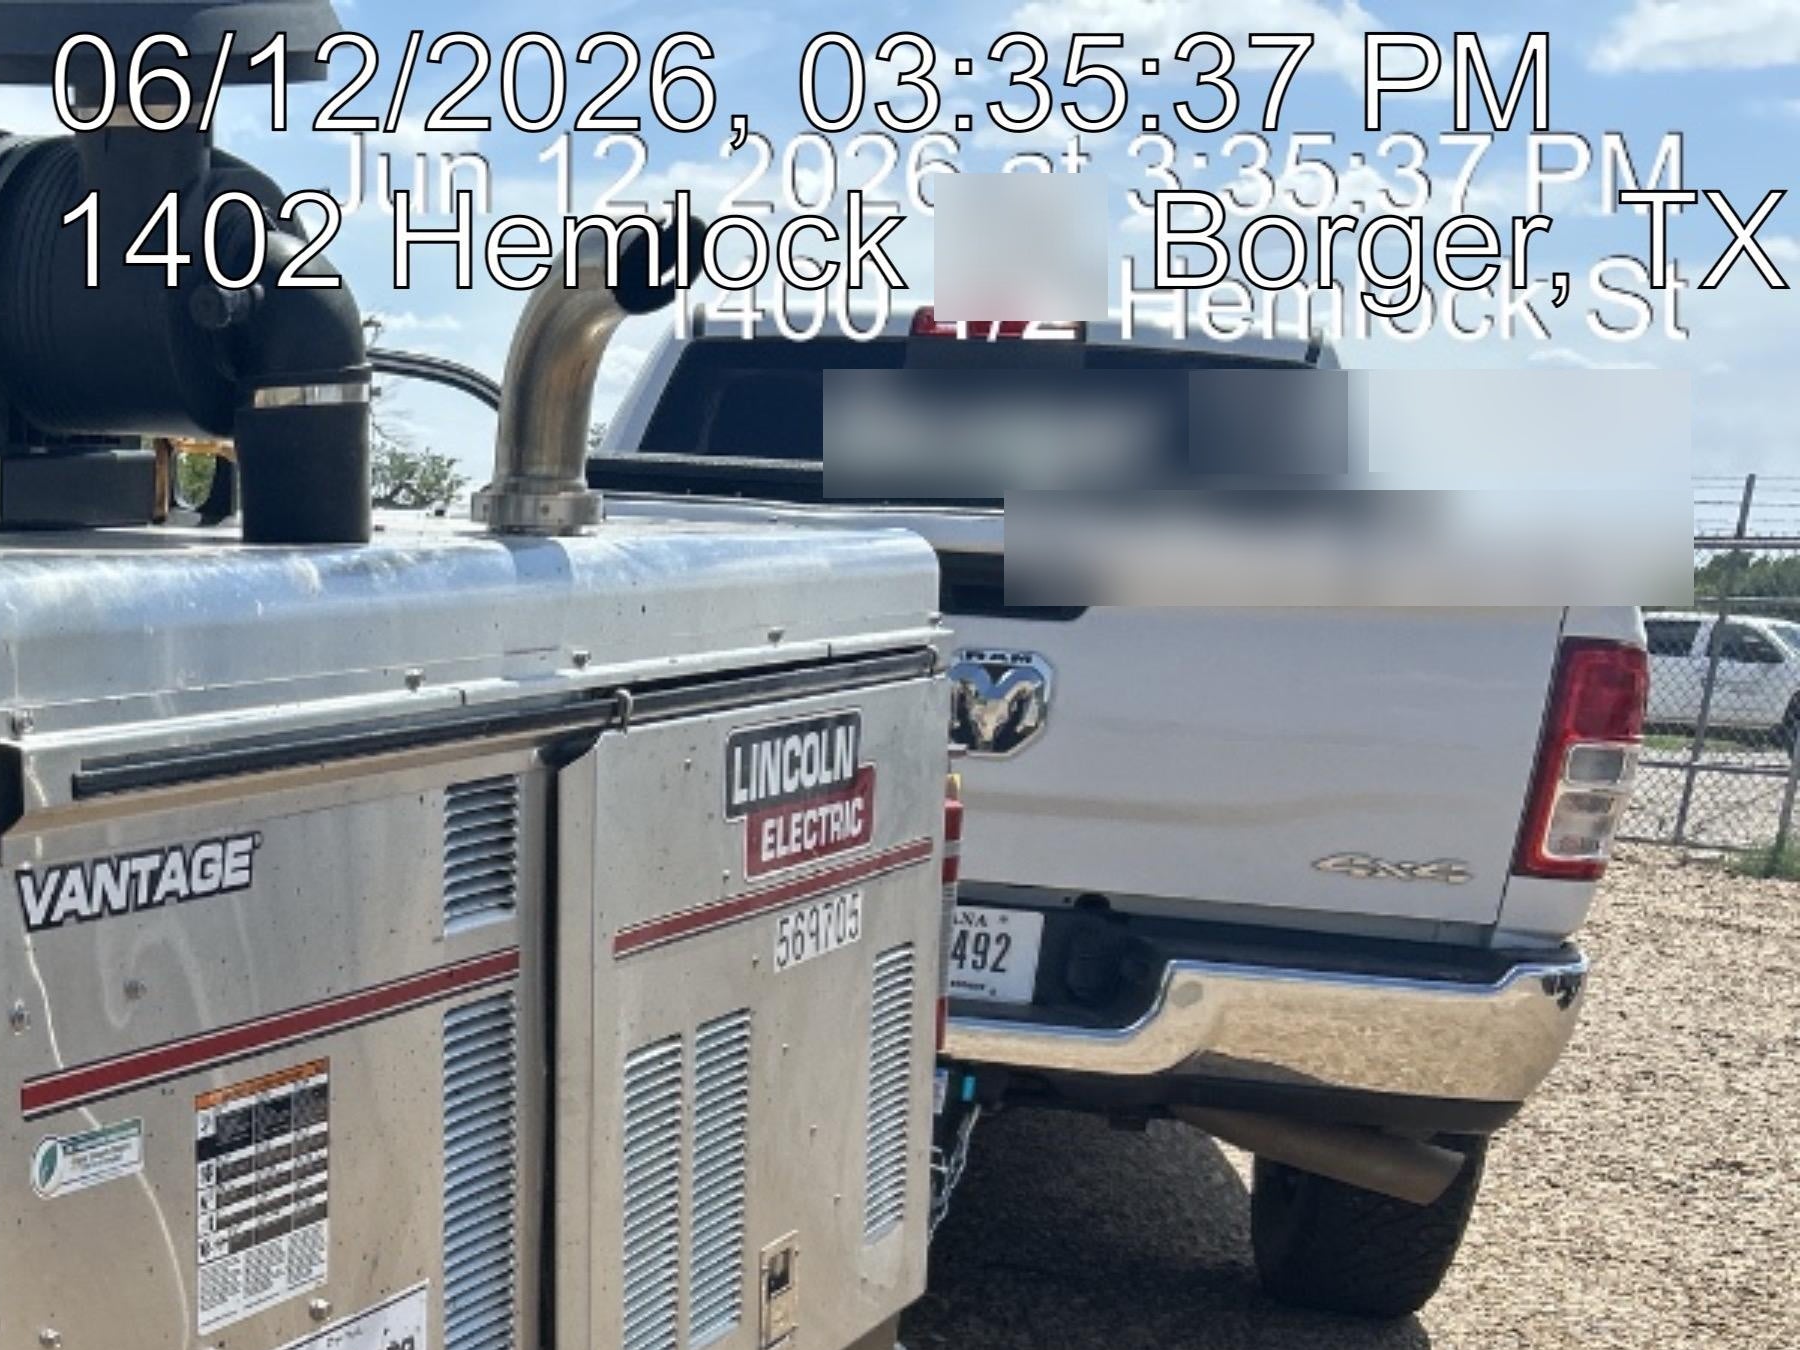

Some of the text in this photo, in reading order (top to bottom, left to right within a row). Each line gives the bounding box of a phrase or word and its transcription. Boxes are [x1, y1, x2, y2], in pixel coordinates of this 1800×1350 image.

[732, 724, 856, 804] LINCOLN
[761, 797, 864, 862] ELECTRIC
[17, 833, 256, 930] VANTAGE
[777, 893, 859, 967] 569705
[951, 929, 1012, 973] 492
